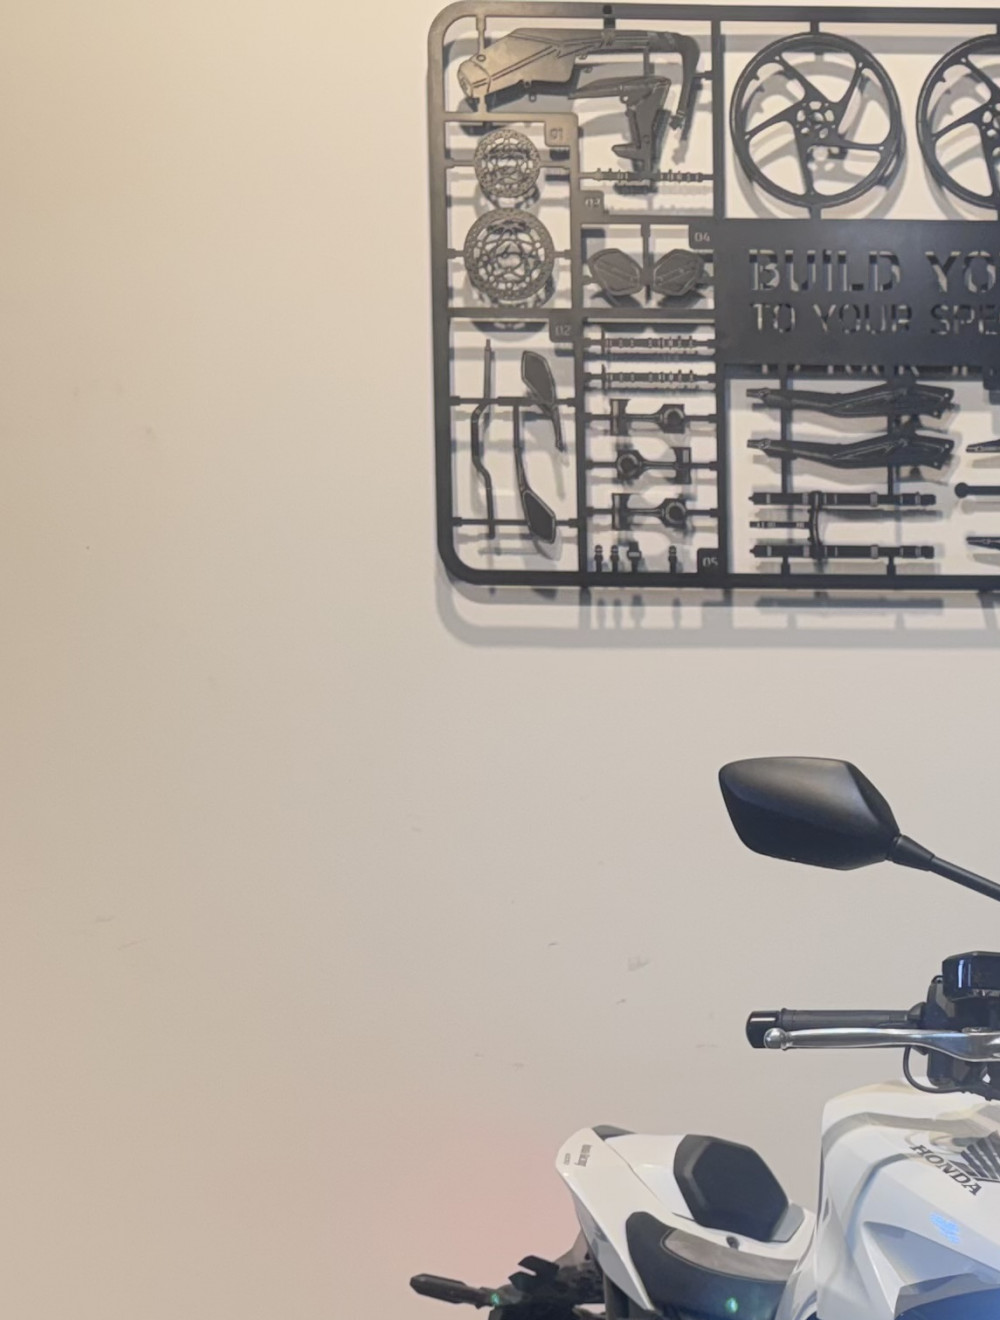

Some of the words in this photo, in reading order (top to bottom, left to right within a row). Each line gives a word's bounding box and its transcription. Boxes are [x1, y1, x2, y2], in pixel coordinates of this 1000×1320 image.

[694, 231, 711, 242] 04
[749, 248, 902, 293] BUILD
[751, 303, 796, 334] TO
[813, 303, 913, 335] YOUR
[909, 1144, 982, 1196] HONDA
